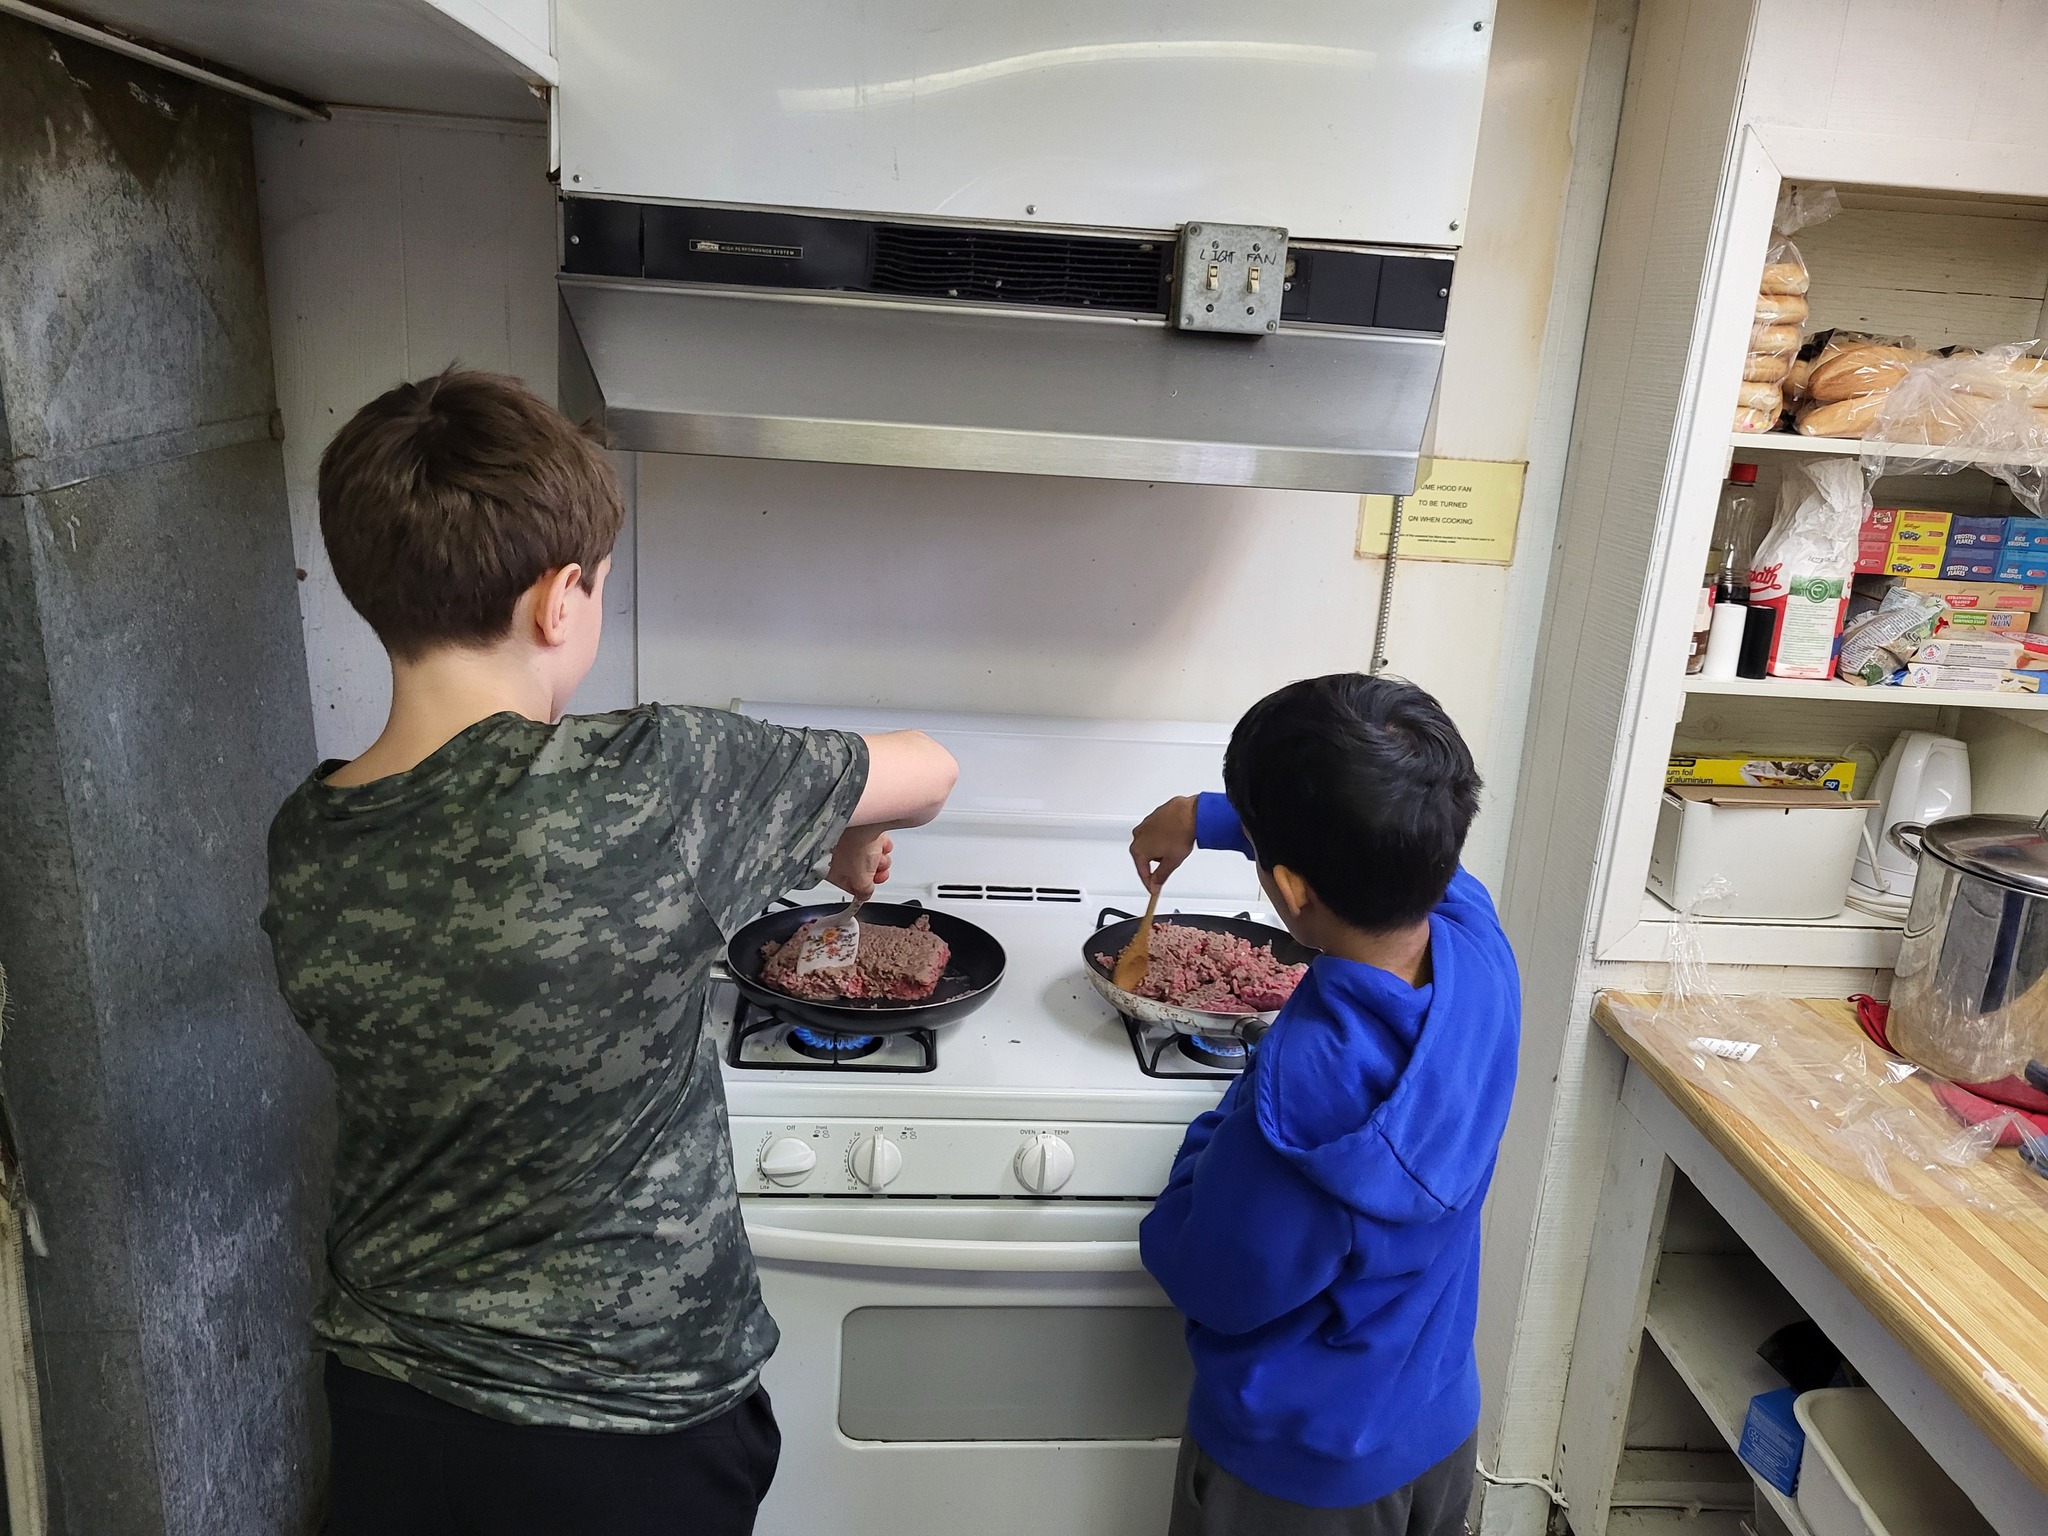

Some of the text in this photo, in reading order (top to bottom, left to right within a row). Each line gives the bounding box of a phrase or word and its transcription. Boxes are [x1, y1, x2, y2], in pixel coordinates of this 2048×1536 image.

[735, 246, 772, 254] PERFORMANCE
[1199, 249, 1277, 265] LIGHT FAN
[1442, 517, 1473, 525] COOKING
[1954, 533, 1977, 541] FROSTED
